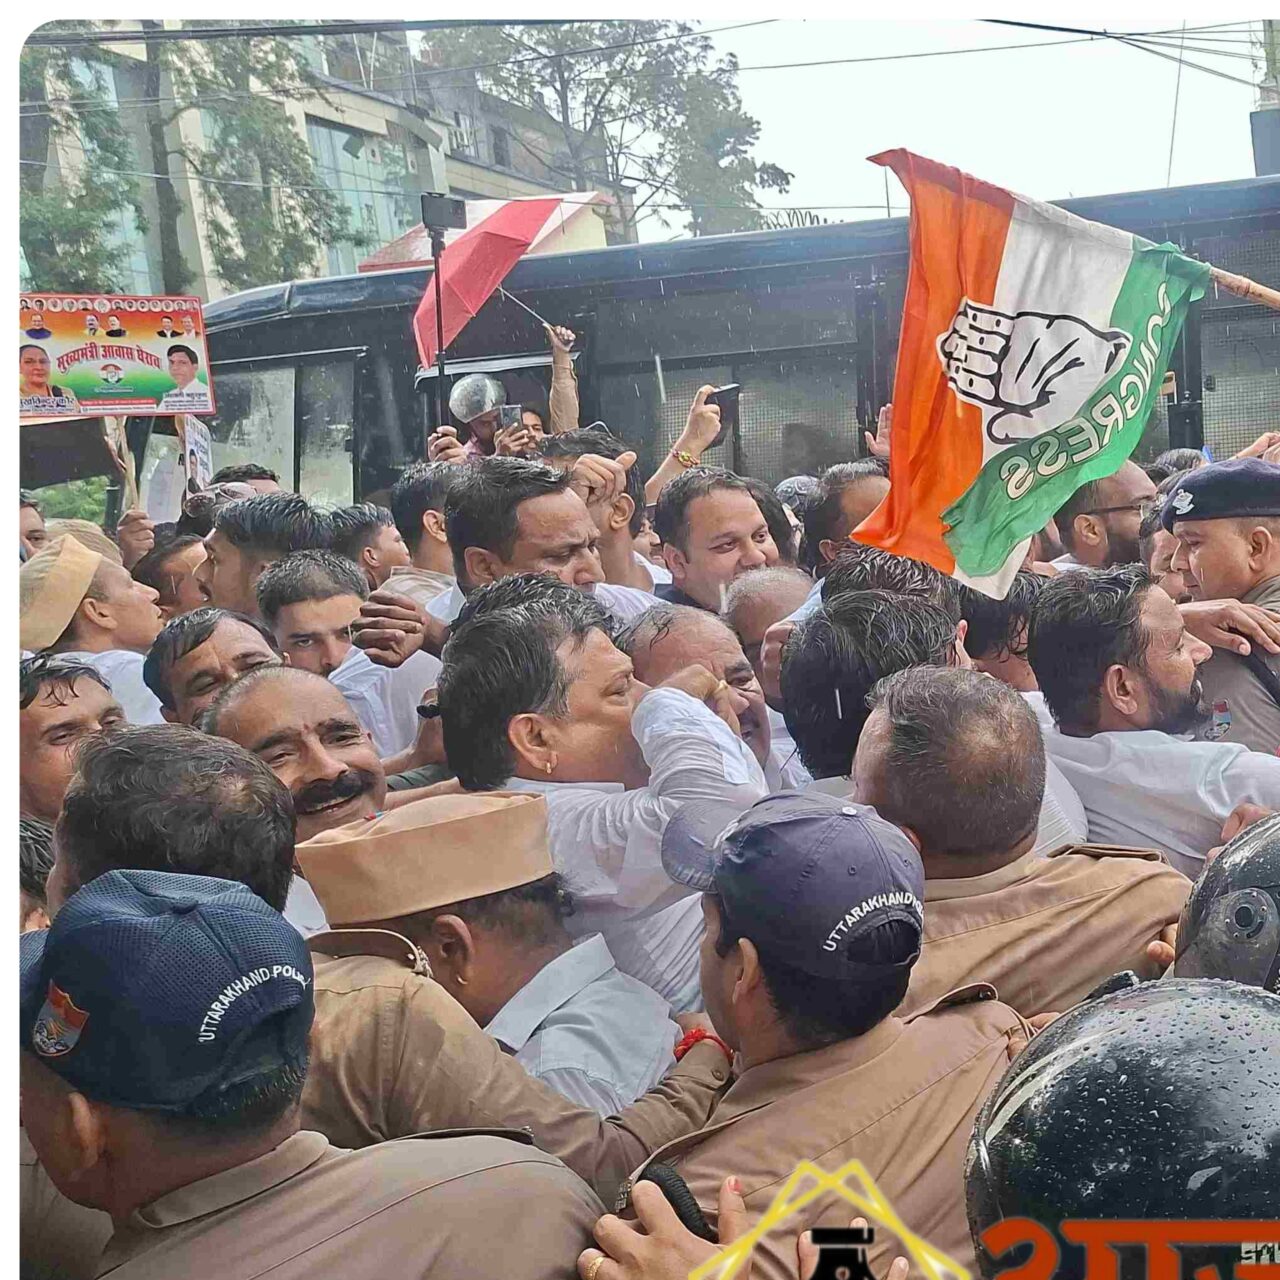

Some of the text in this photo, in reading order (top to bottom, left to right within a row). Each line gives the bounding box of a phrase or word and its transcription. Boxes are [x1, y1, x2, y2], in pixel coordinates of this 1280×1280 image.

[101, 345, 134, 359] आवास
[822, 891, 913, 952] UTTARAKHAND
[198, 967, 271, 1042] UTTARAKHAND
